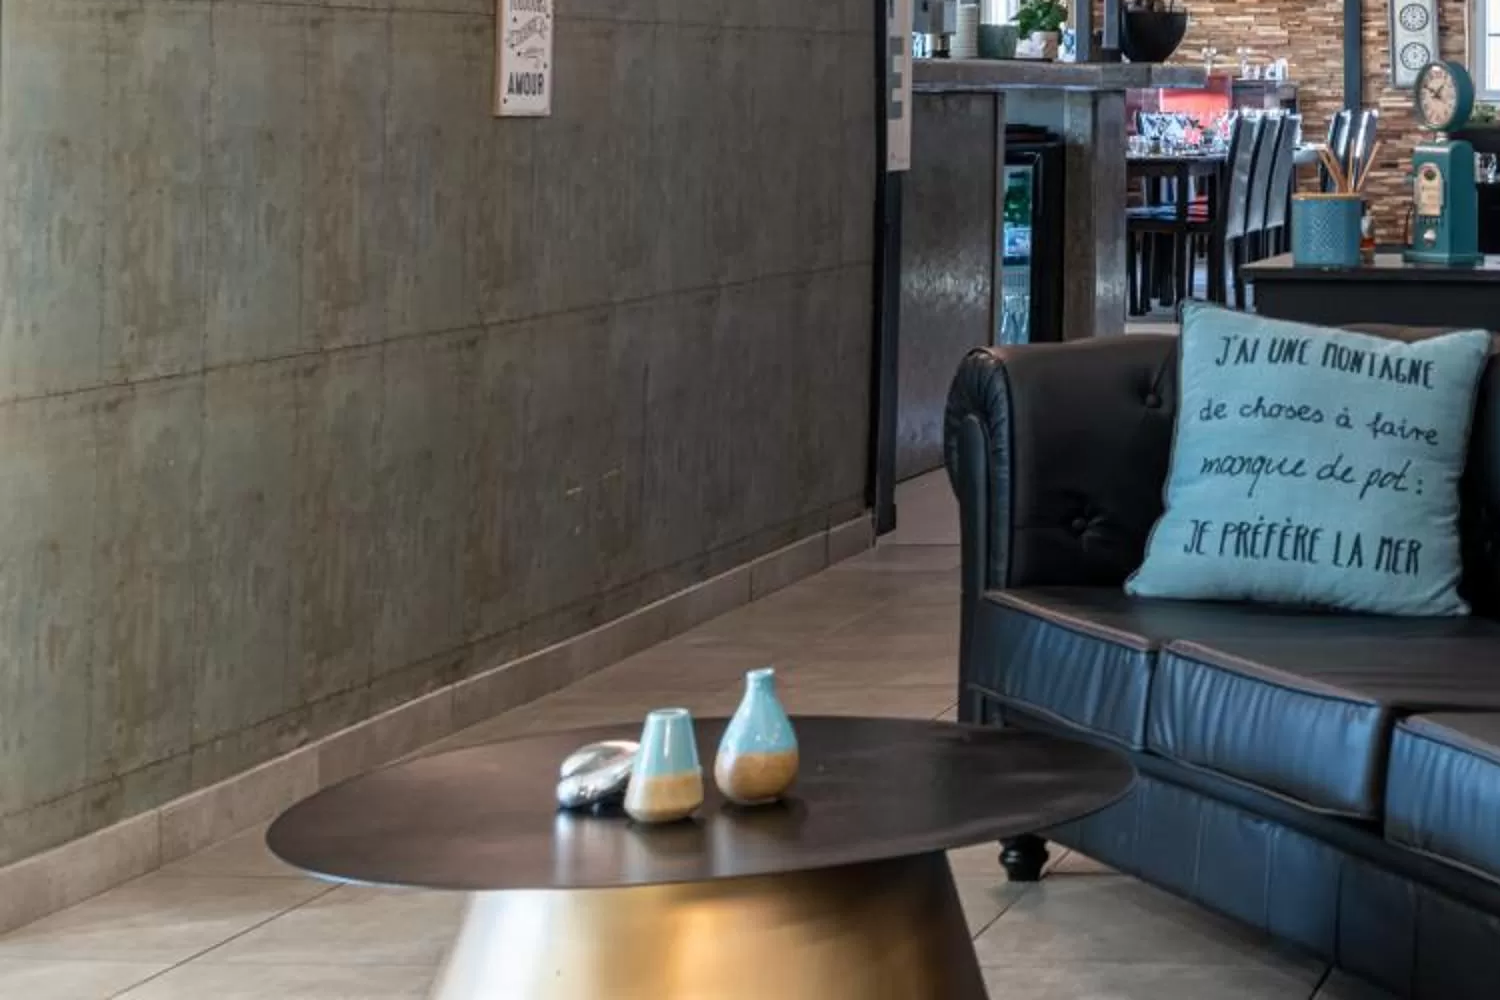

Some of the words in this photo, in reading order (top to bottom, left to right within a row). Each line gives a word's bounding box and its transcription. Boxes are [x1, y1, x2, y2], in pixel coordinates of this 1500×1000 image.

[507, 71, 545, 96] AMOUR
[1216, 336, 1262, 367] J'AI
[1267, 336, 1311, 366] UNE
[1321, 342, 1435, 390] MONTAGNE
[1199, 398, 1228, 422] de
[1239, 396, 1325, 425] choses
[1336, 406, 1353, 429] à
[1365, 411, 1440, 446] faire
[1200, 454, 1308, 498] manque
[1316, 455, 1356, 484] de
[1183, 519, 1214, 555] JE
[1218, 515, 1325, 565] PRÉFÈRE
[1331, 530, 1365, 570] LA
[1374, 537, 1424, 576] MER
